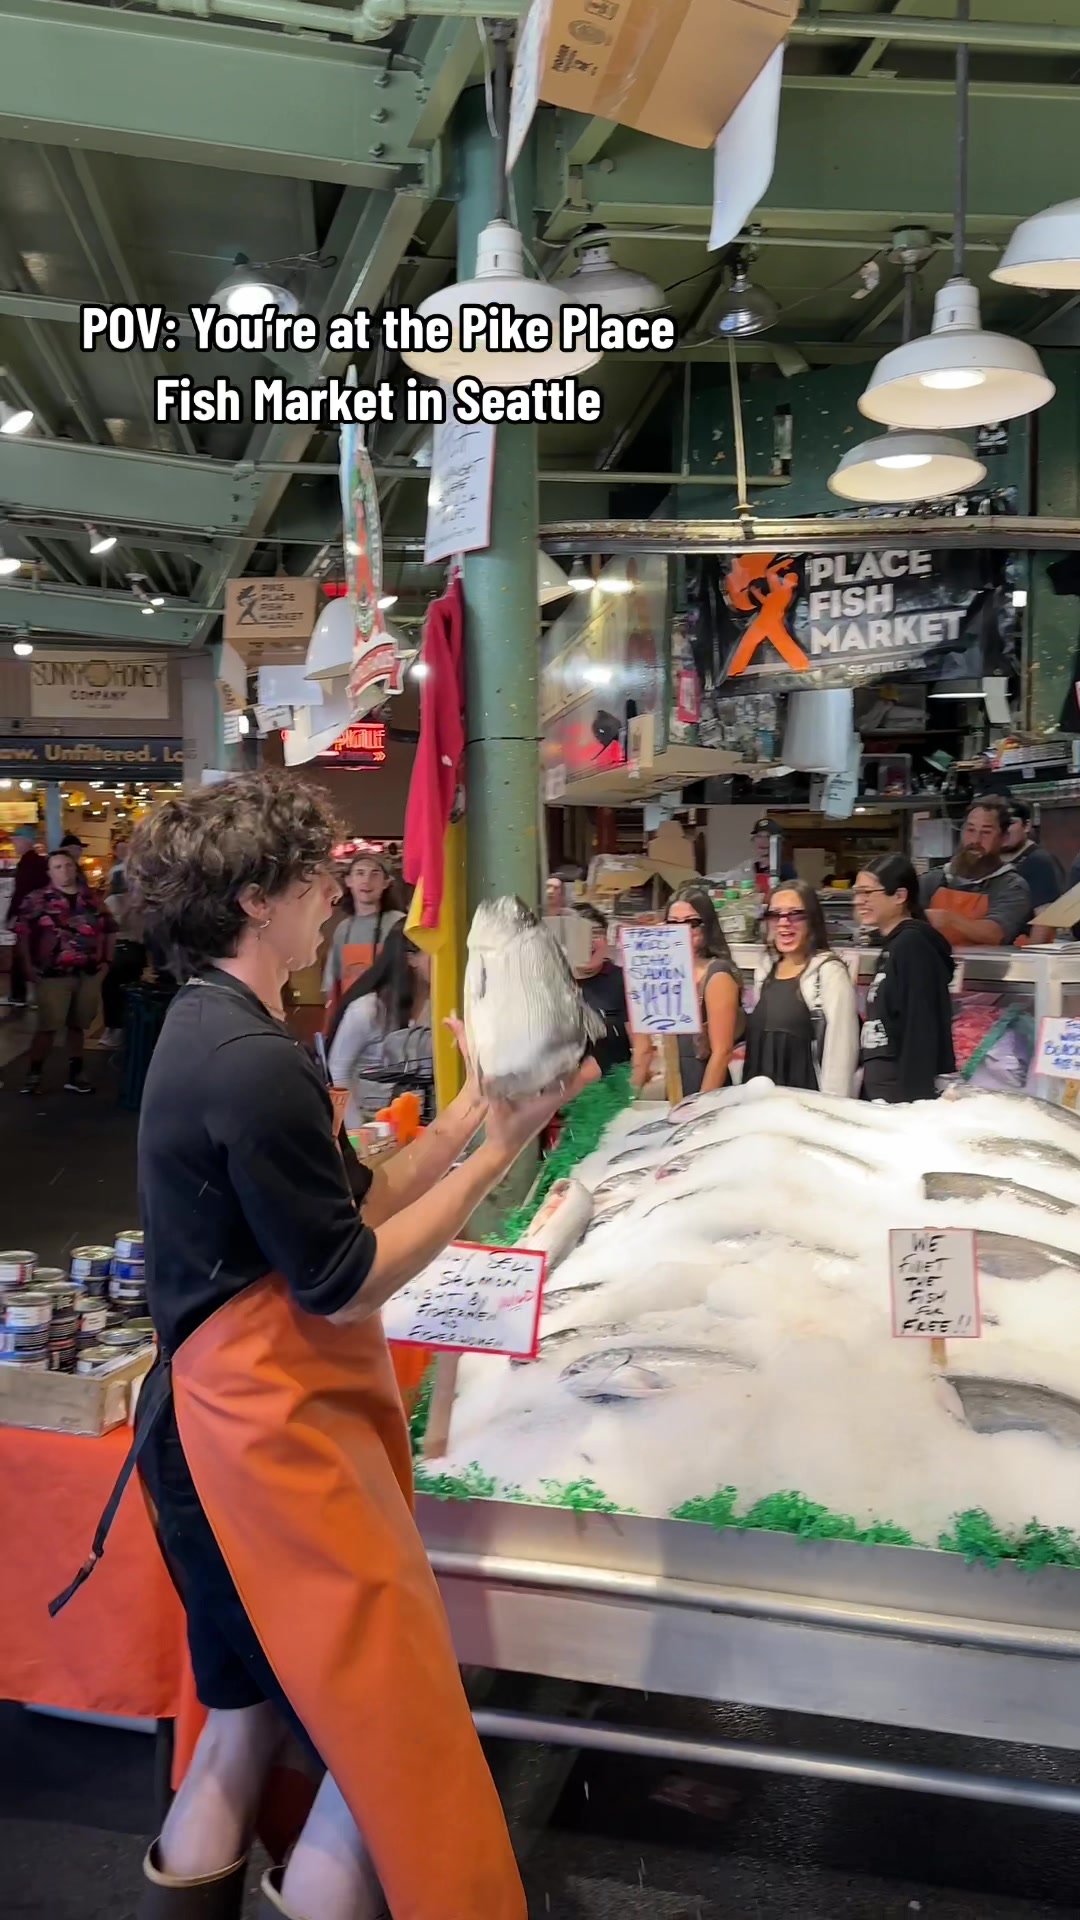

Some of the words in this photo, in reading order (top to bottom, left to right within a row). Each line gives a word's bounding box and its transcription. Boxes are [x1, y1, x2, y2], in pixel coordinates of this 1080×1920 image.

[810, 549, 932, 586] PLACE
[809, 583, 894, 621] FISH
[809, 609, 967, 655] MARKET
[70, 690, 127, 701] COMPANY
[912, 1233, 945, 1252] WE
[907, 1289, 947, 1304] FISH
